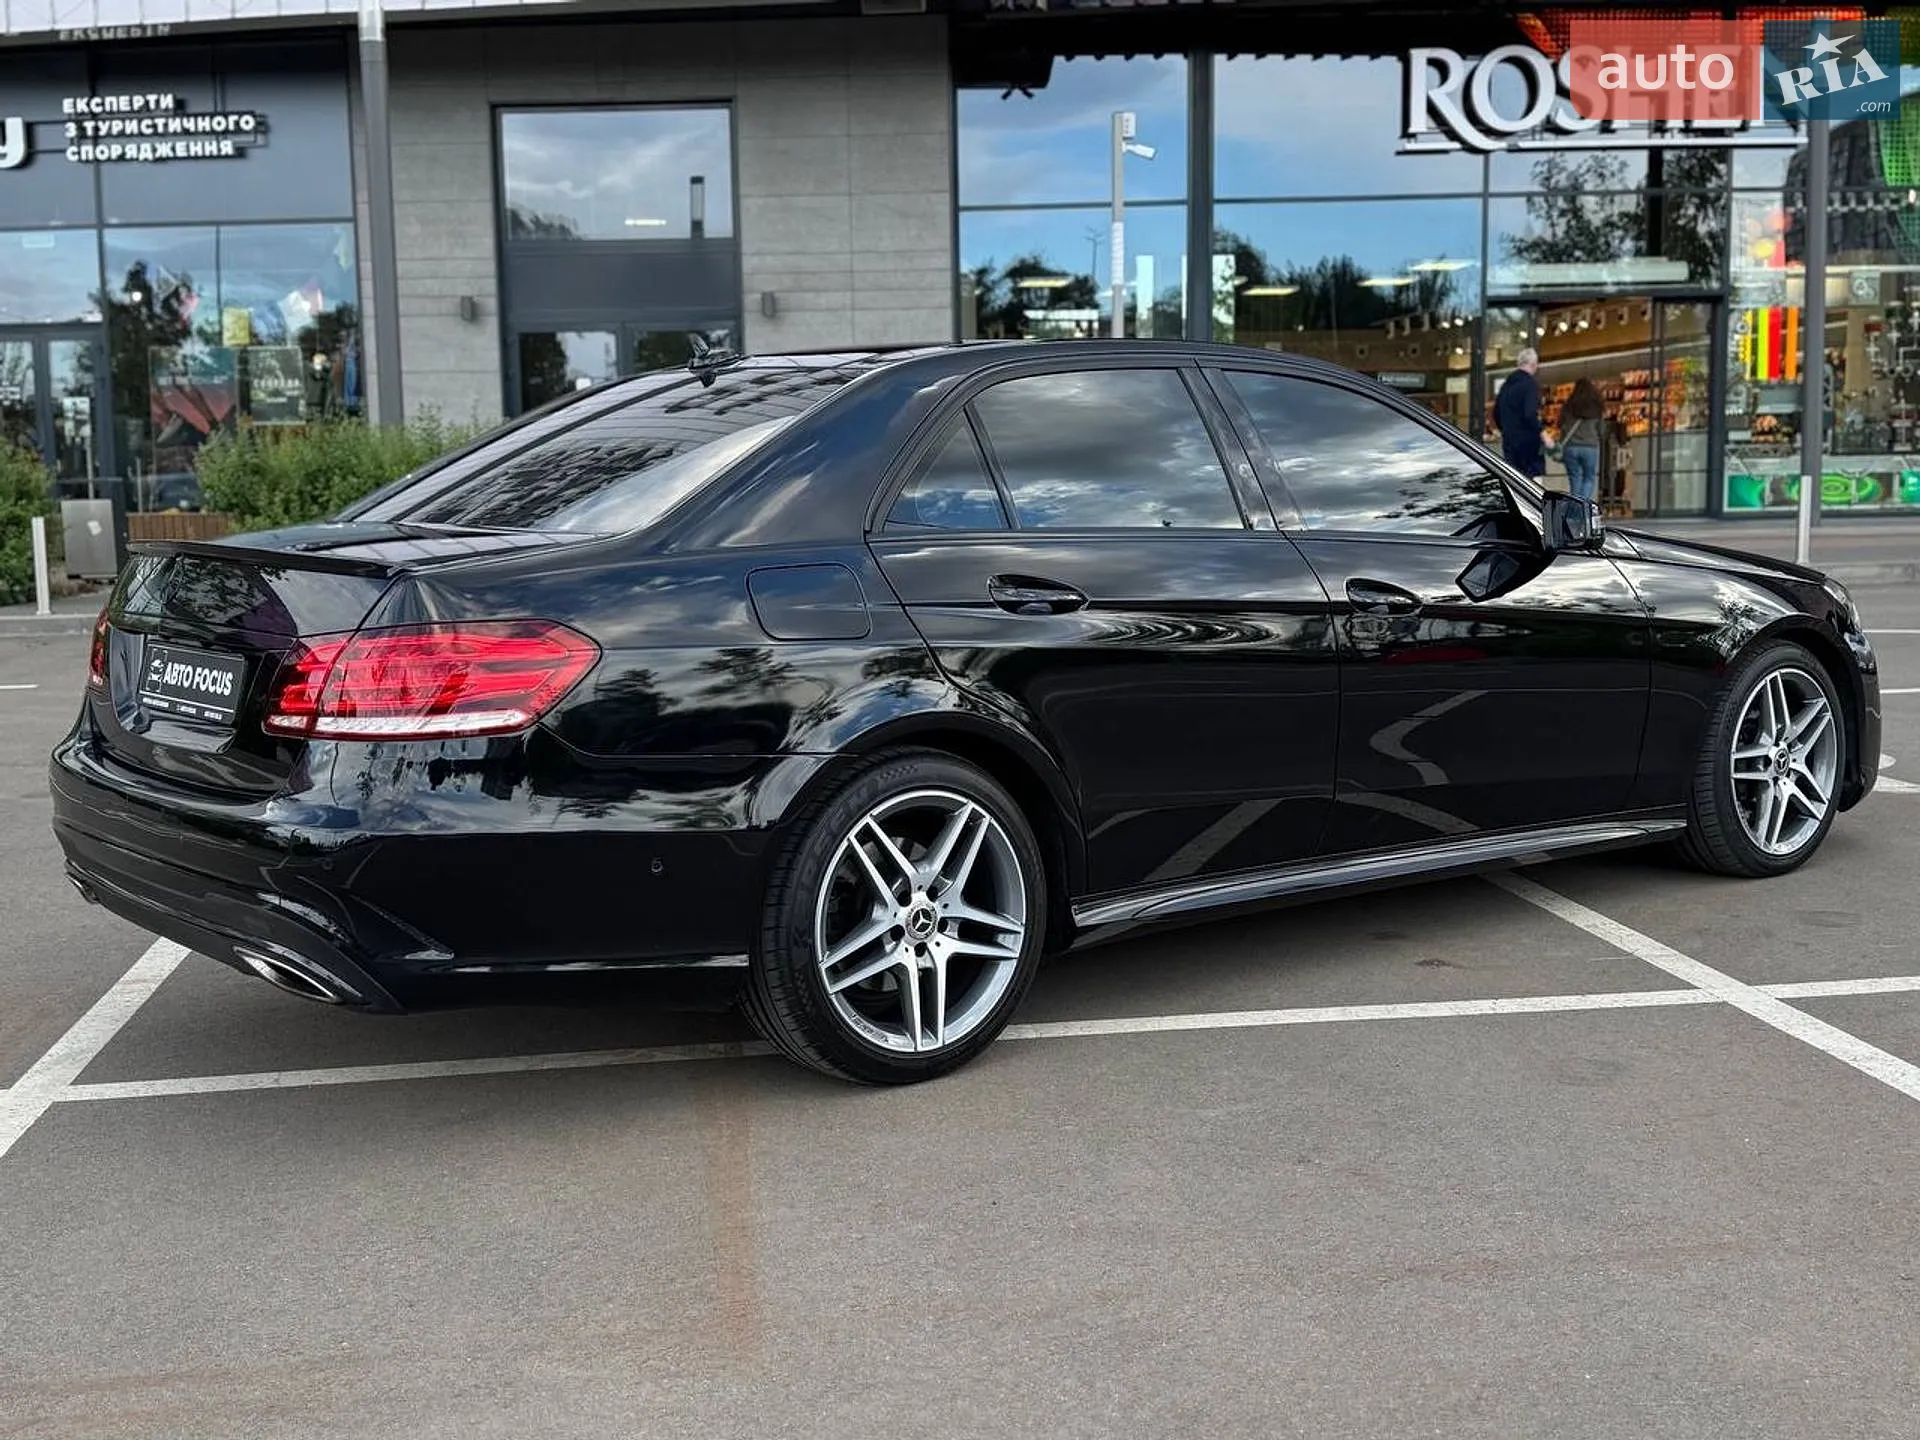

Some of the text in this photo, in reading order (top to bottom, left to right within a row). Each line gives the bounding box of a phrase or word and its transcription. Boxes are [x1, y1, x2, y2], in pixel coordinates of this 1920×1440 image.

[61, 93, 175, 114] ЕКСПЕРТИ
[83, 114, 256, 138] ТУРИСТИЧНОГО
[66, 139, 235, 162] СПОРЯДЖЕННЯ
[192, 666, 233, 696] FOCUS
